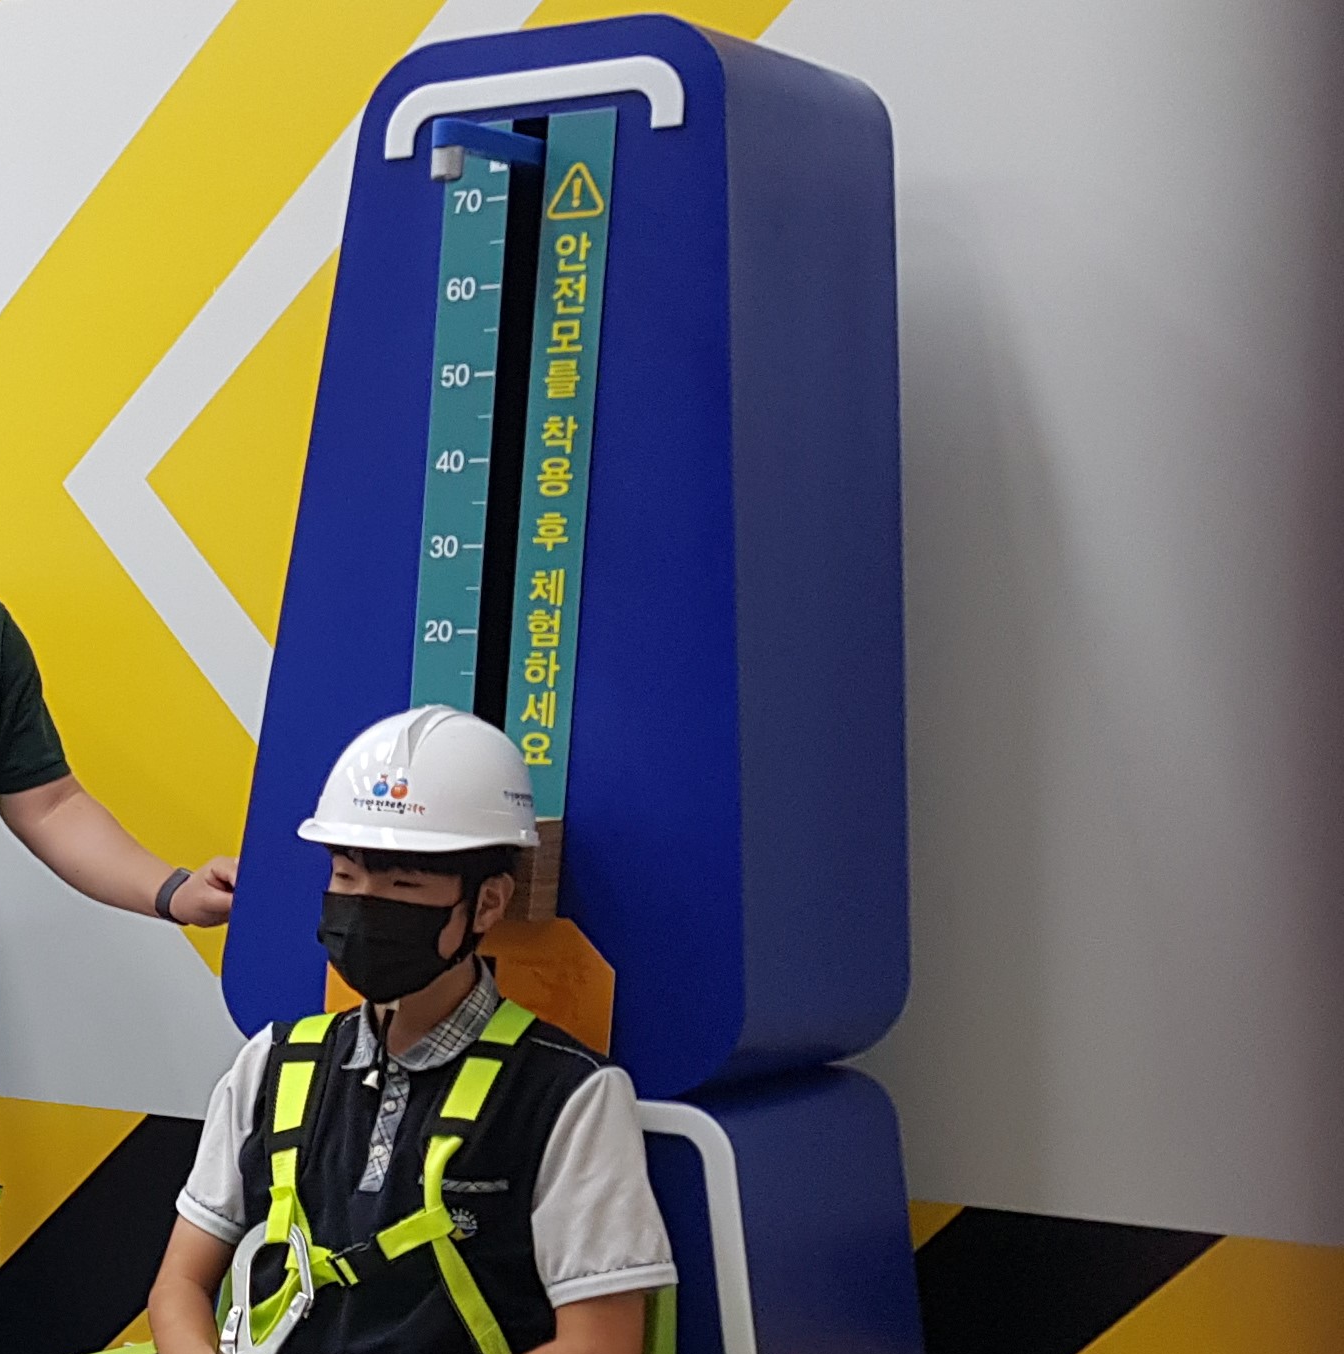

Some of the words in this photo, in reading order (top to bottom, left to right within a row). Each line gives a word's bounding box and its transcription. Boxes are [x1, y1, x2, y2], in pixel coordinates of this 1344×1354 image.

[453, 189, 482, 214] 70
[446, 277, 476, 301] 60
[545, 232, 591, 399] 안전모를
[441, 364, 470, 388] 50
[435, 450, 464, 473] 40
[538, 416, 578, 497] 착용
[532, 512, 569, 552] 후
[429, 535, 458, 558] 30
[424, 620, 452, 643] 20
[521, 568, 566, 766] 체험하세요
